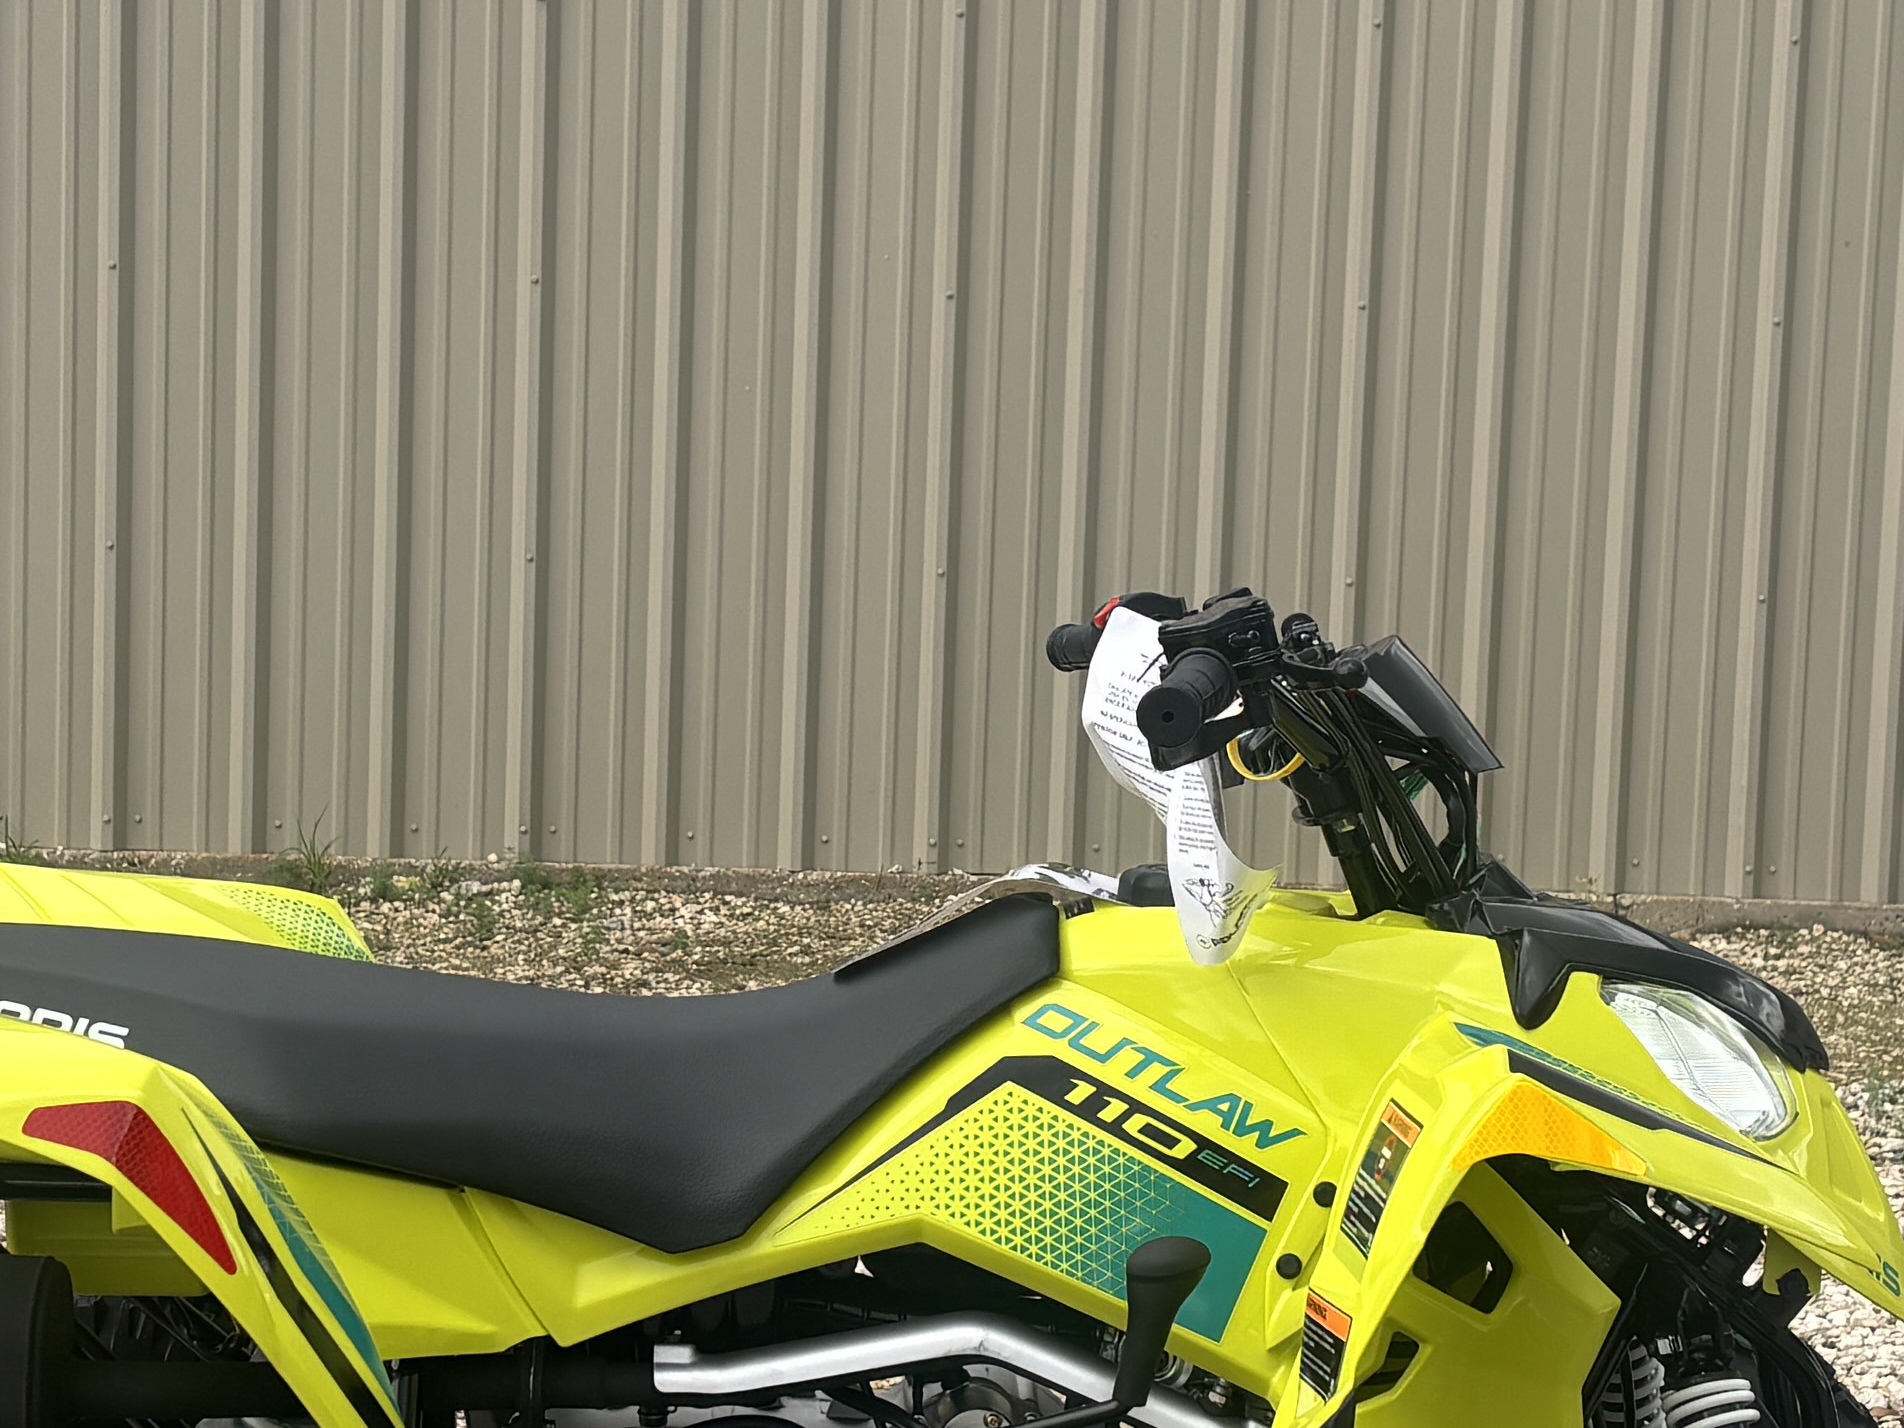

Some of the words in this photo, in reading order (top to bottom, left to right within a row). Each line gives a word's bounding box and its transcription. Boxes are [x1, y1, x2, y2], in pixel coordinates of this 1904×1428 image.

[1020, 1003, 1308, 1150] OUTLAW
[1063, 1079, 1197, 1160] 110
[1197, 1149, 1261, 1188] EFI
